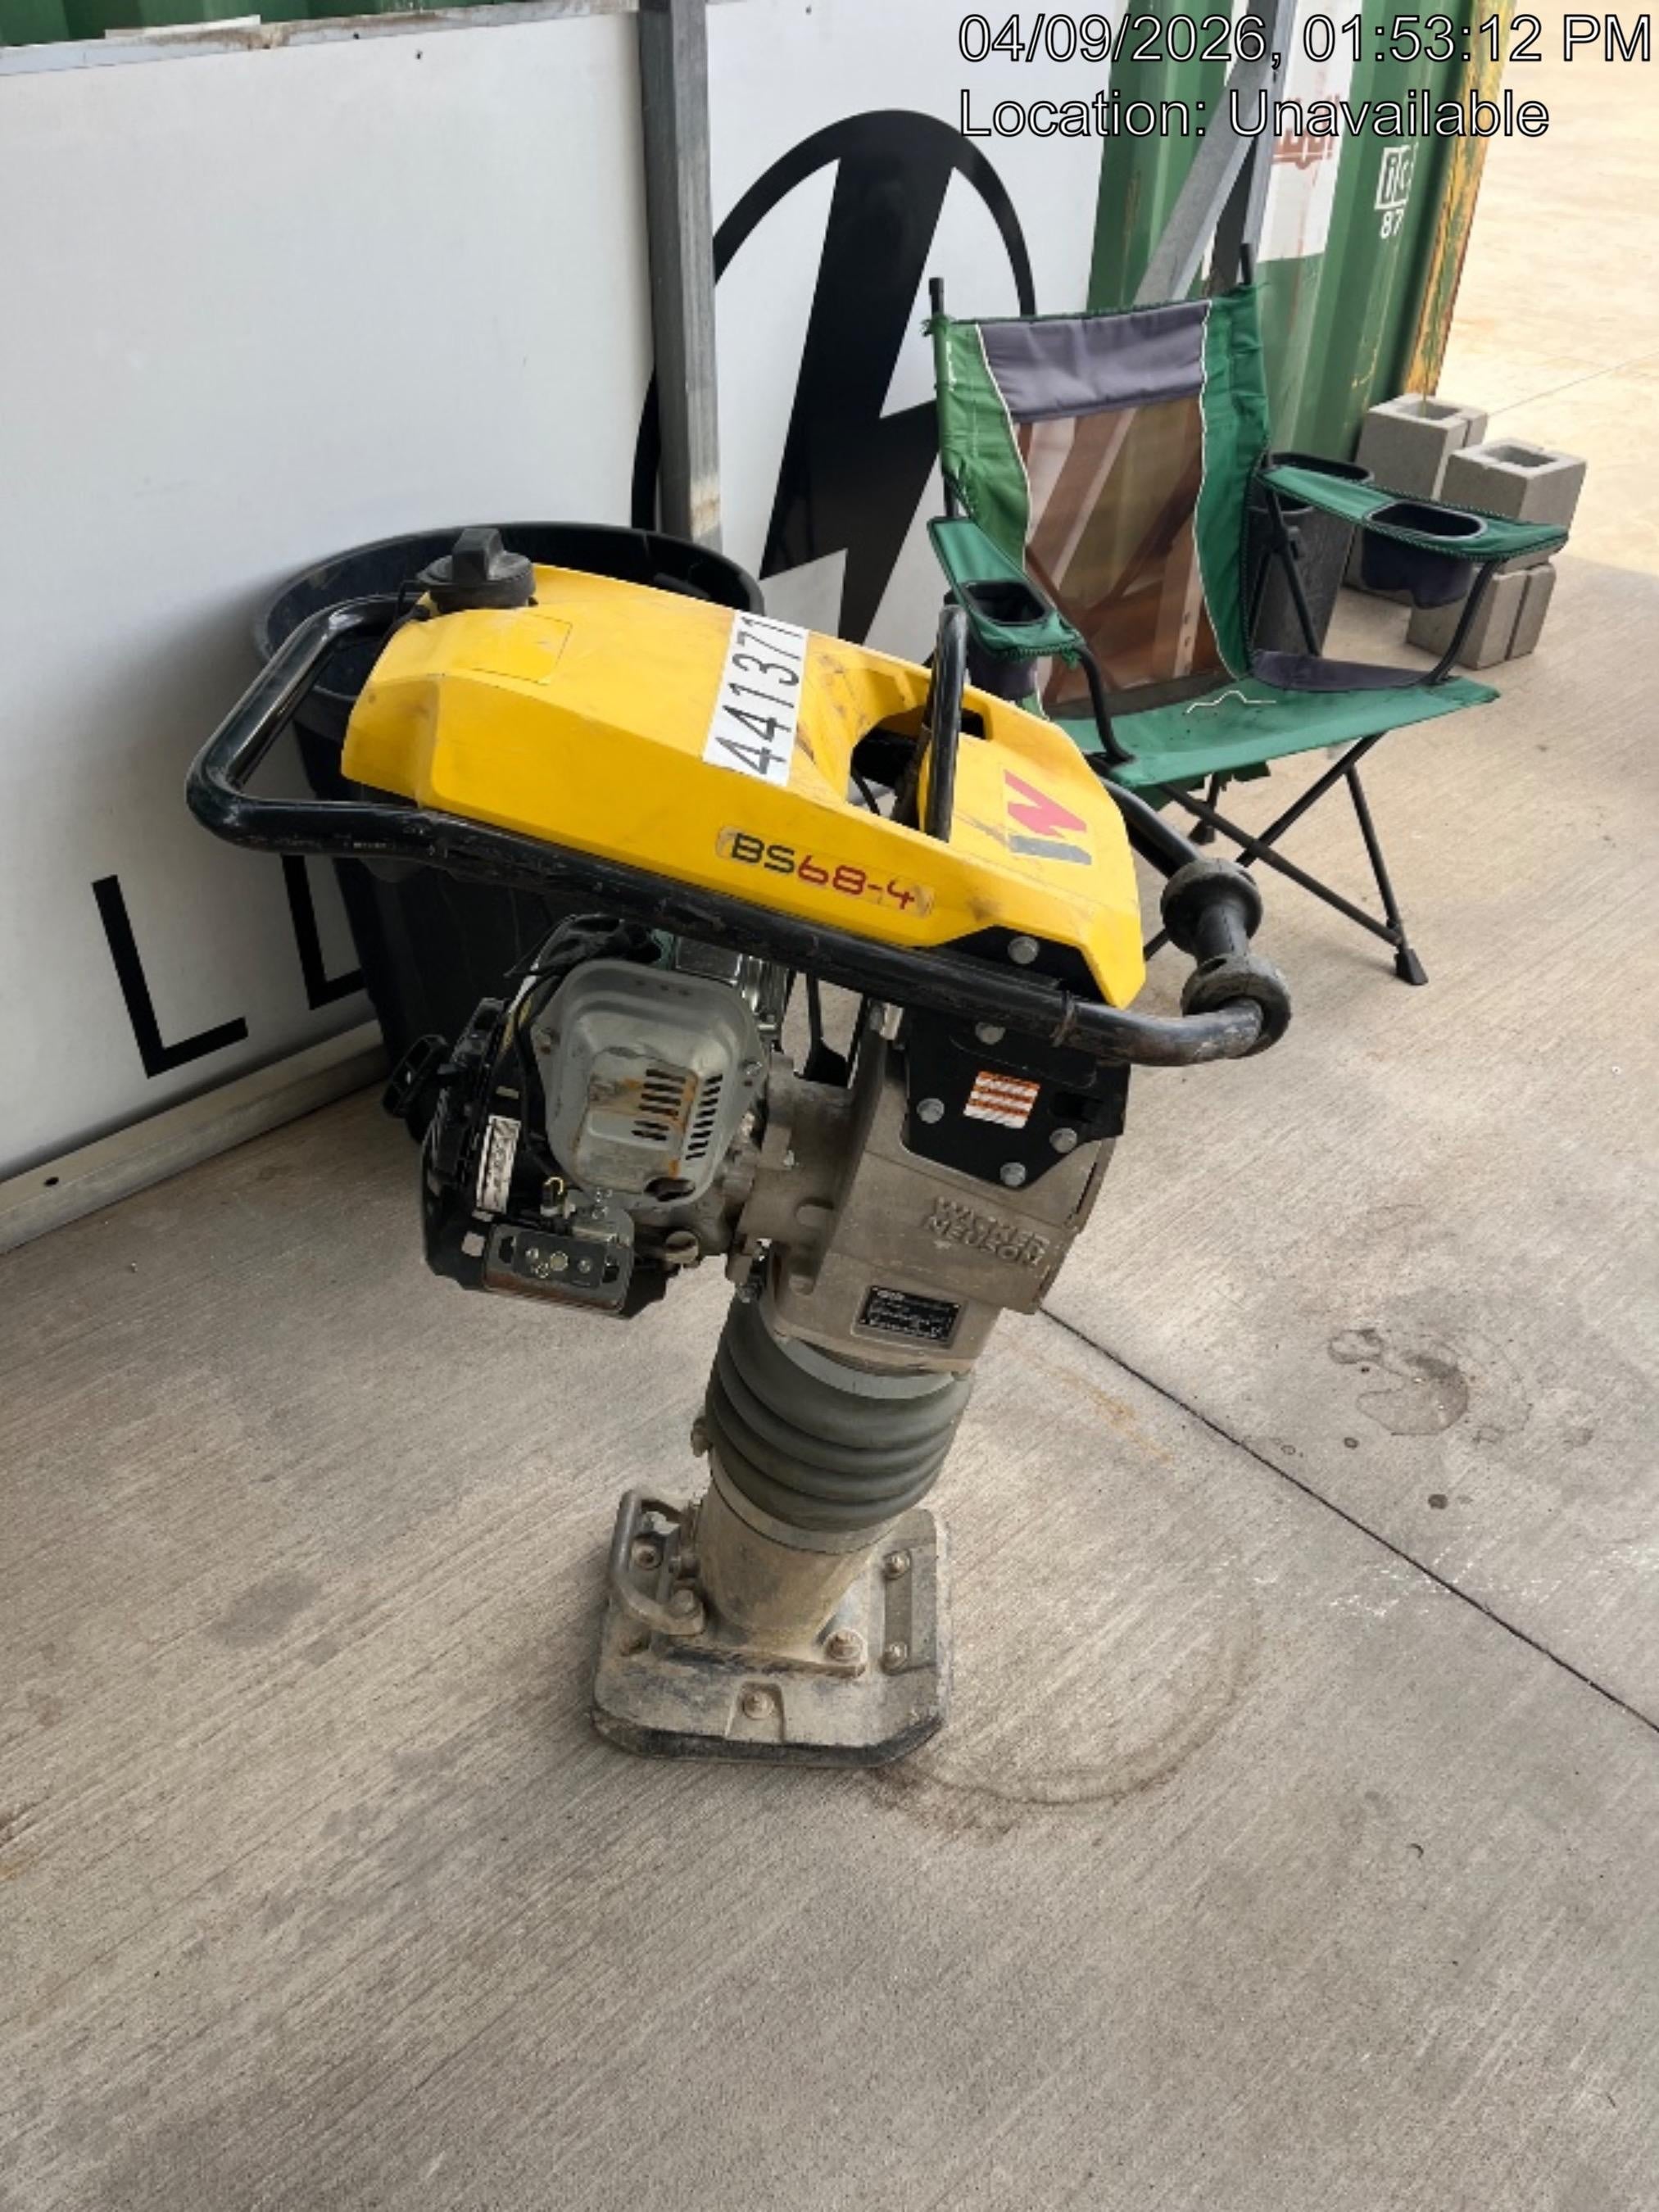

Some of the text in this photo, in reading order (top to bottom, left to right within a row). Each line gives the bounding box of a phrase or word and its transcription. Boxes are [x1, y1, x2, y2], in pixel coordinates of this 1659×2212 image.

[1380, 207, 1405, 239] 87
[714, 616, 803, 775] 441371
[732, 832, 915, 910] BS68-4
